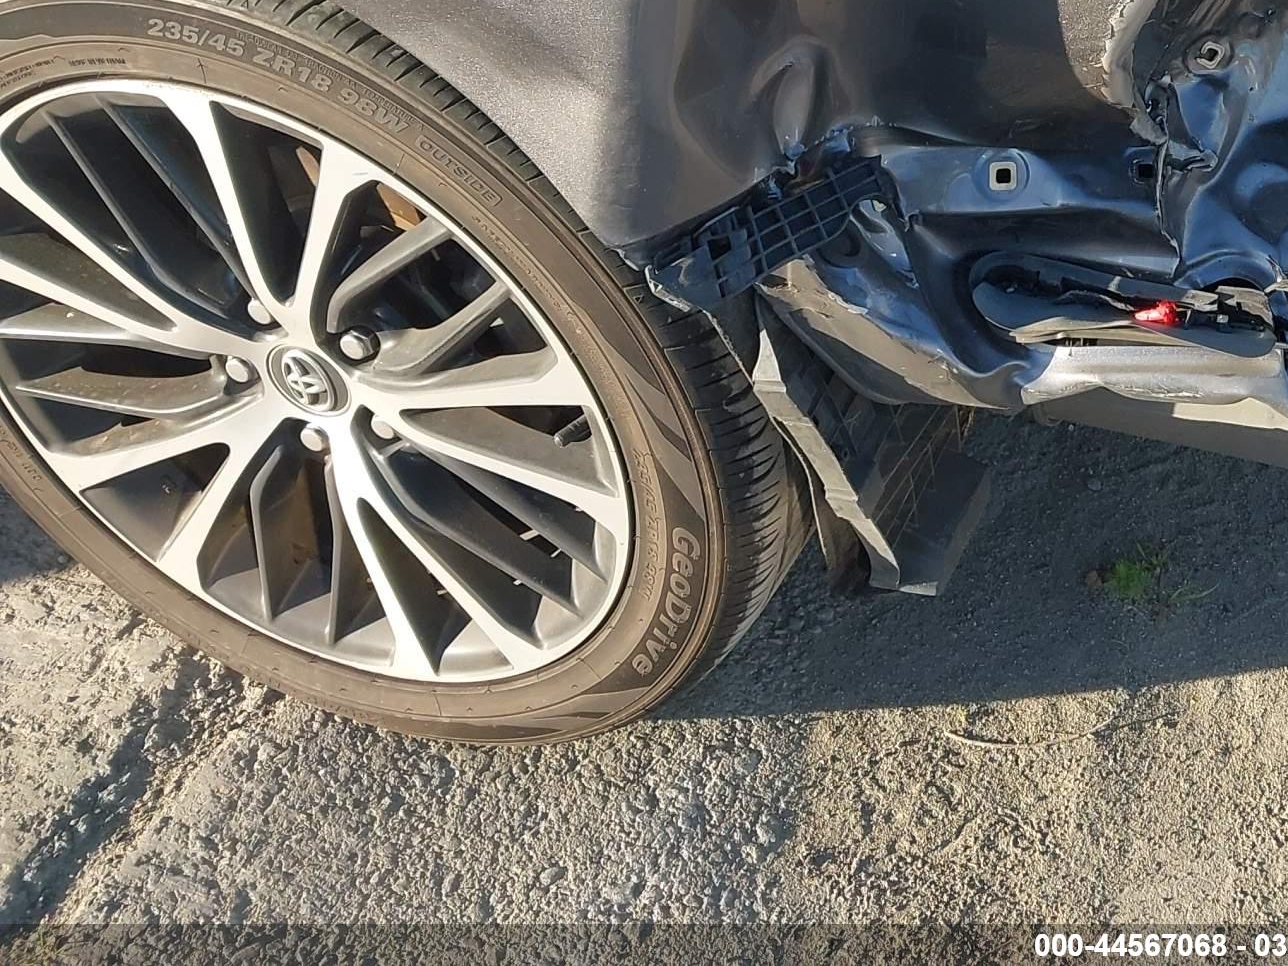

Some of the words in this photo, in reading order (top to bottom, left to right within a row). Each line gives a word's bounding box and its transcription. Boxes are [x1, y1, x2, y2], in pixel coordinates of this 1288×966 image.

[147, 18, 246, 57] 235/45
[252, 46, 333, 93] ZR18
[338, 87, 410, 134] 98W
[419, 139, 498, 203] OUTSIDE
[632, 526, 701, 676] GeoDrive
